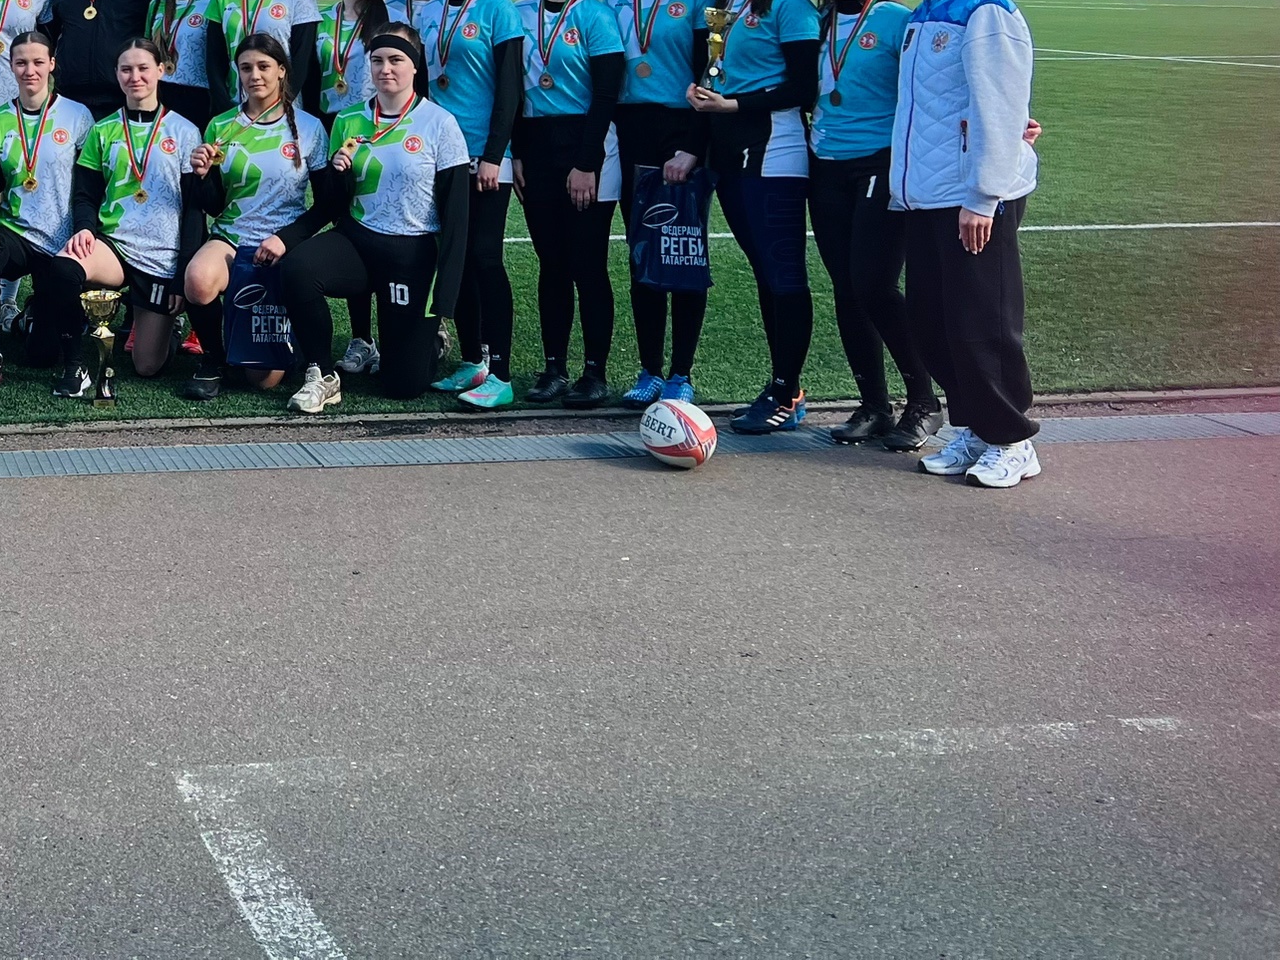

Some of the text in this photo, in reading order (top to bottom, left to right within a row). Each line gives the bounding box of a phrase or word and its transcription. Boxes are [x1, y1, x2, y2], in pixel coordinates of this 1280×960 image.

[469, 157, 479, 174] 3
[661, 225, 702, 237] ФЕДЕРАЦИ
[150, 283, 165, 305] 11
[389, 282, 409, 305] 10
[252, 304, 287, 315] ФЕДЕРАЦИ
[251, 315, 291, 334] РЕГБИ
[640, 413, 677, 439] LBERT
